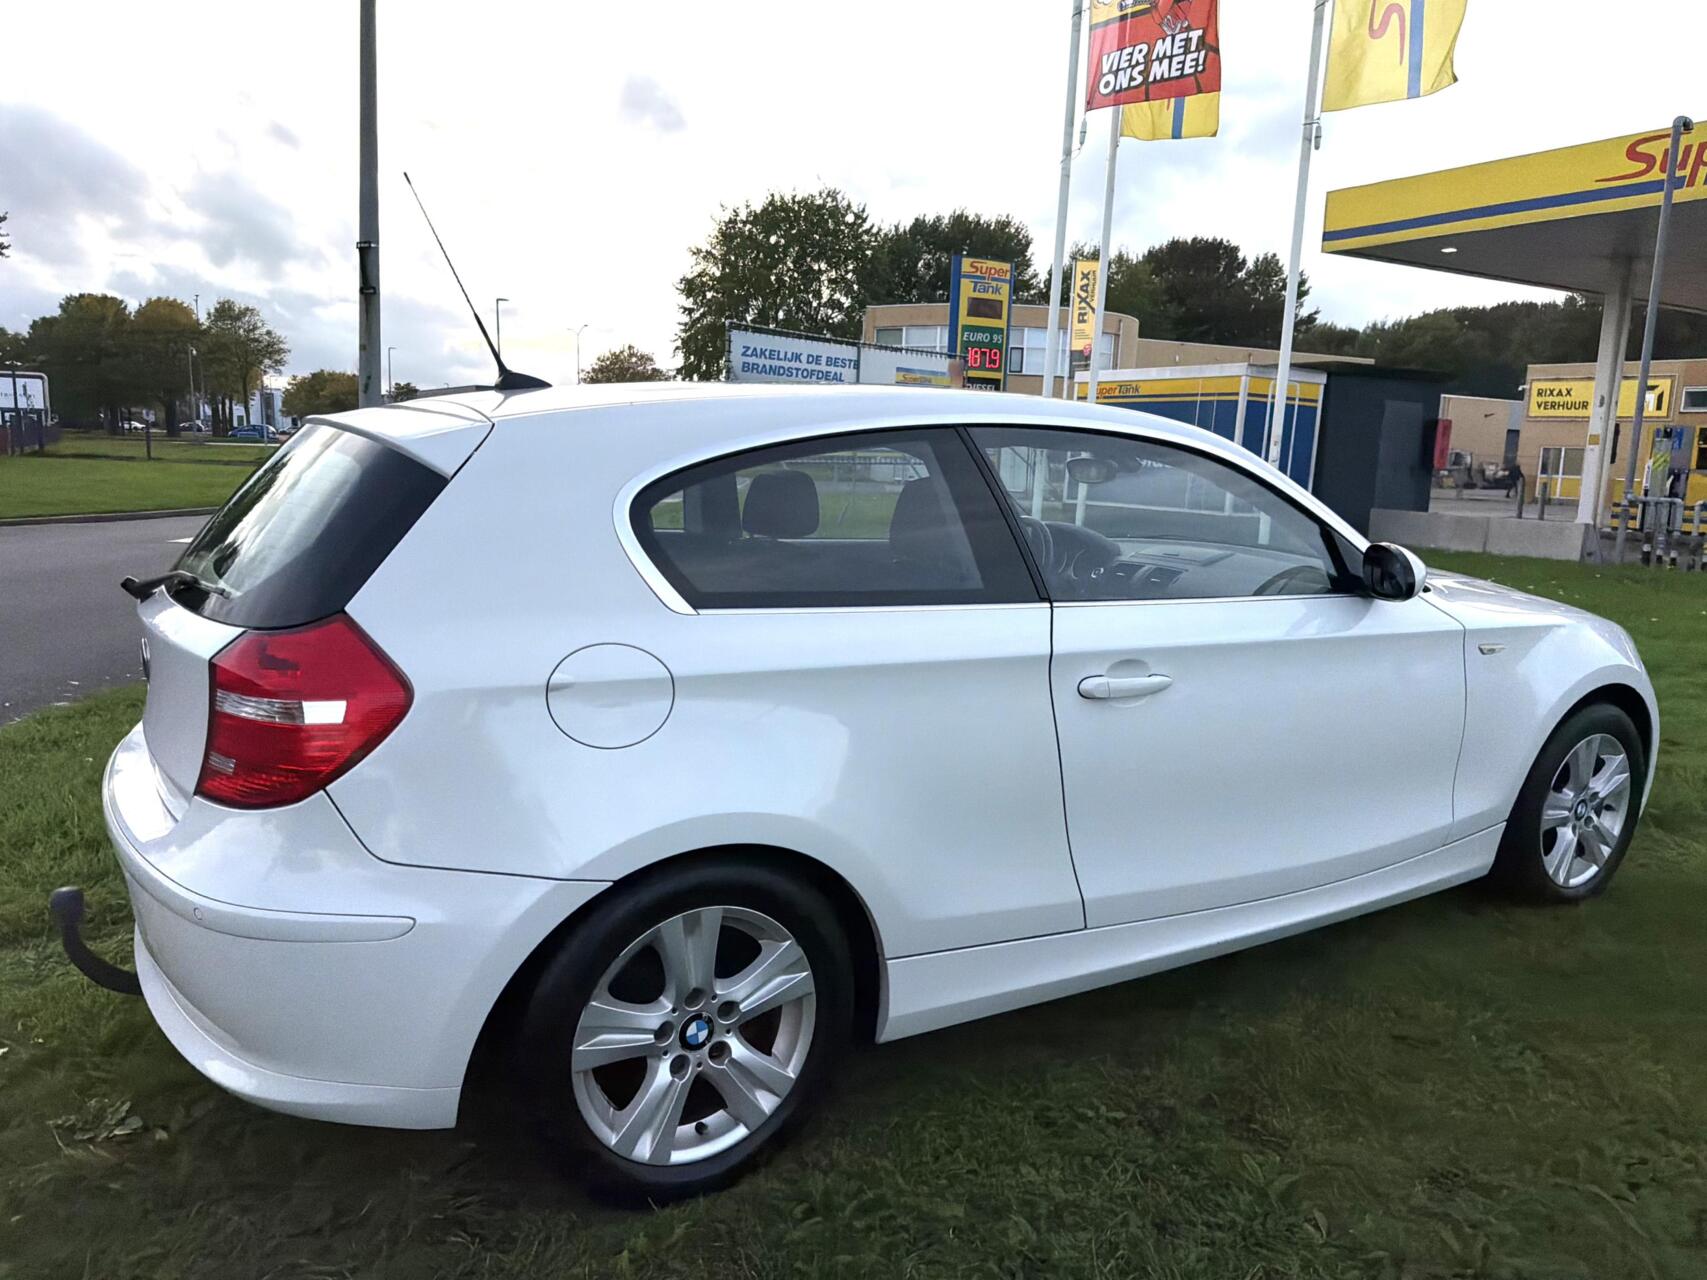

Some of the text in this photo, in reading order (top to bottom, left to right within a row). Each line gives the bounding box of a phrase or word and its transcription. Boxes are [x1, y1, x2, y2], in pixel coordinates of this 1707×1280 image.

[1102, 29, 1203, 74] VIER MET
[1099, 50, 1205, 95] ONS MEE!
[961, 260, 1010, 281] Super
[969, 280, 1003, 296] Tank
[1077, 270, 1096, 324] RIXAX
[963, 331, 1003, 344] EURO 95
[741, 345, 803, 364] ZAKELIJK
[806, 353, 823, 366] DE
[741, 361, 845, 383] BRANDSTOFDEAL
[1537, 387, 1573, 398] RIXAX
[1536, 401, 1589, 411] VERHUUR
